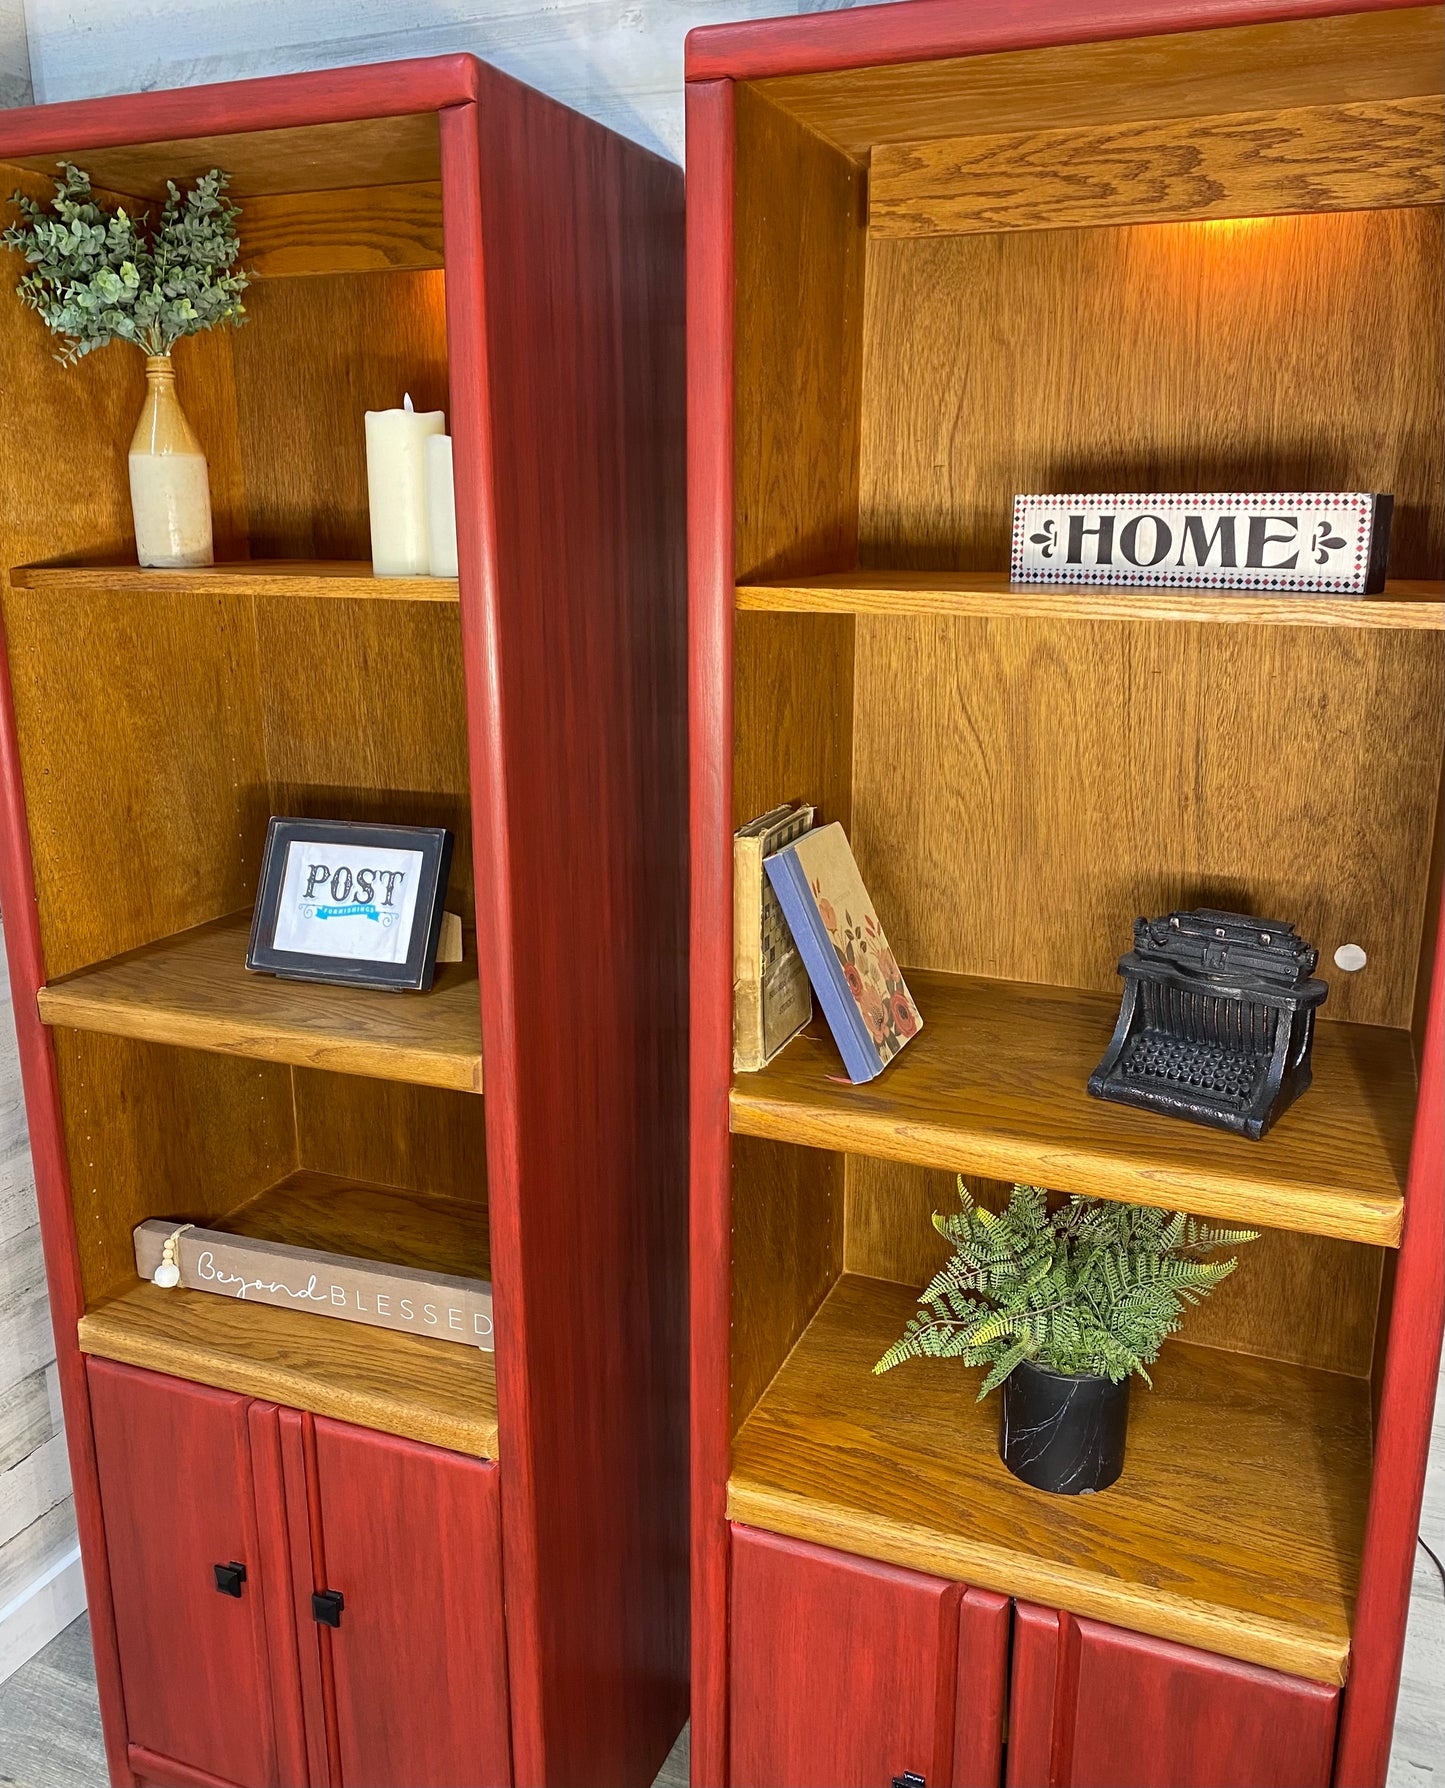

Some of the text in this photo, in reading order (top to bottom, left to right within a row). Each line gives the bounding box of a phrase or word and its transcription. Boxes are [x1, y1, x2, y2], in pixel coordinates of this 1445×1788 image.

[1066, 514, 1300, 570] HOME
[303, 864, 405, 906] POST
[322, 905, 375, 915] FURNISHINGS
[198, 1251, 493, 1335] Beyond BLESSED
